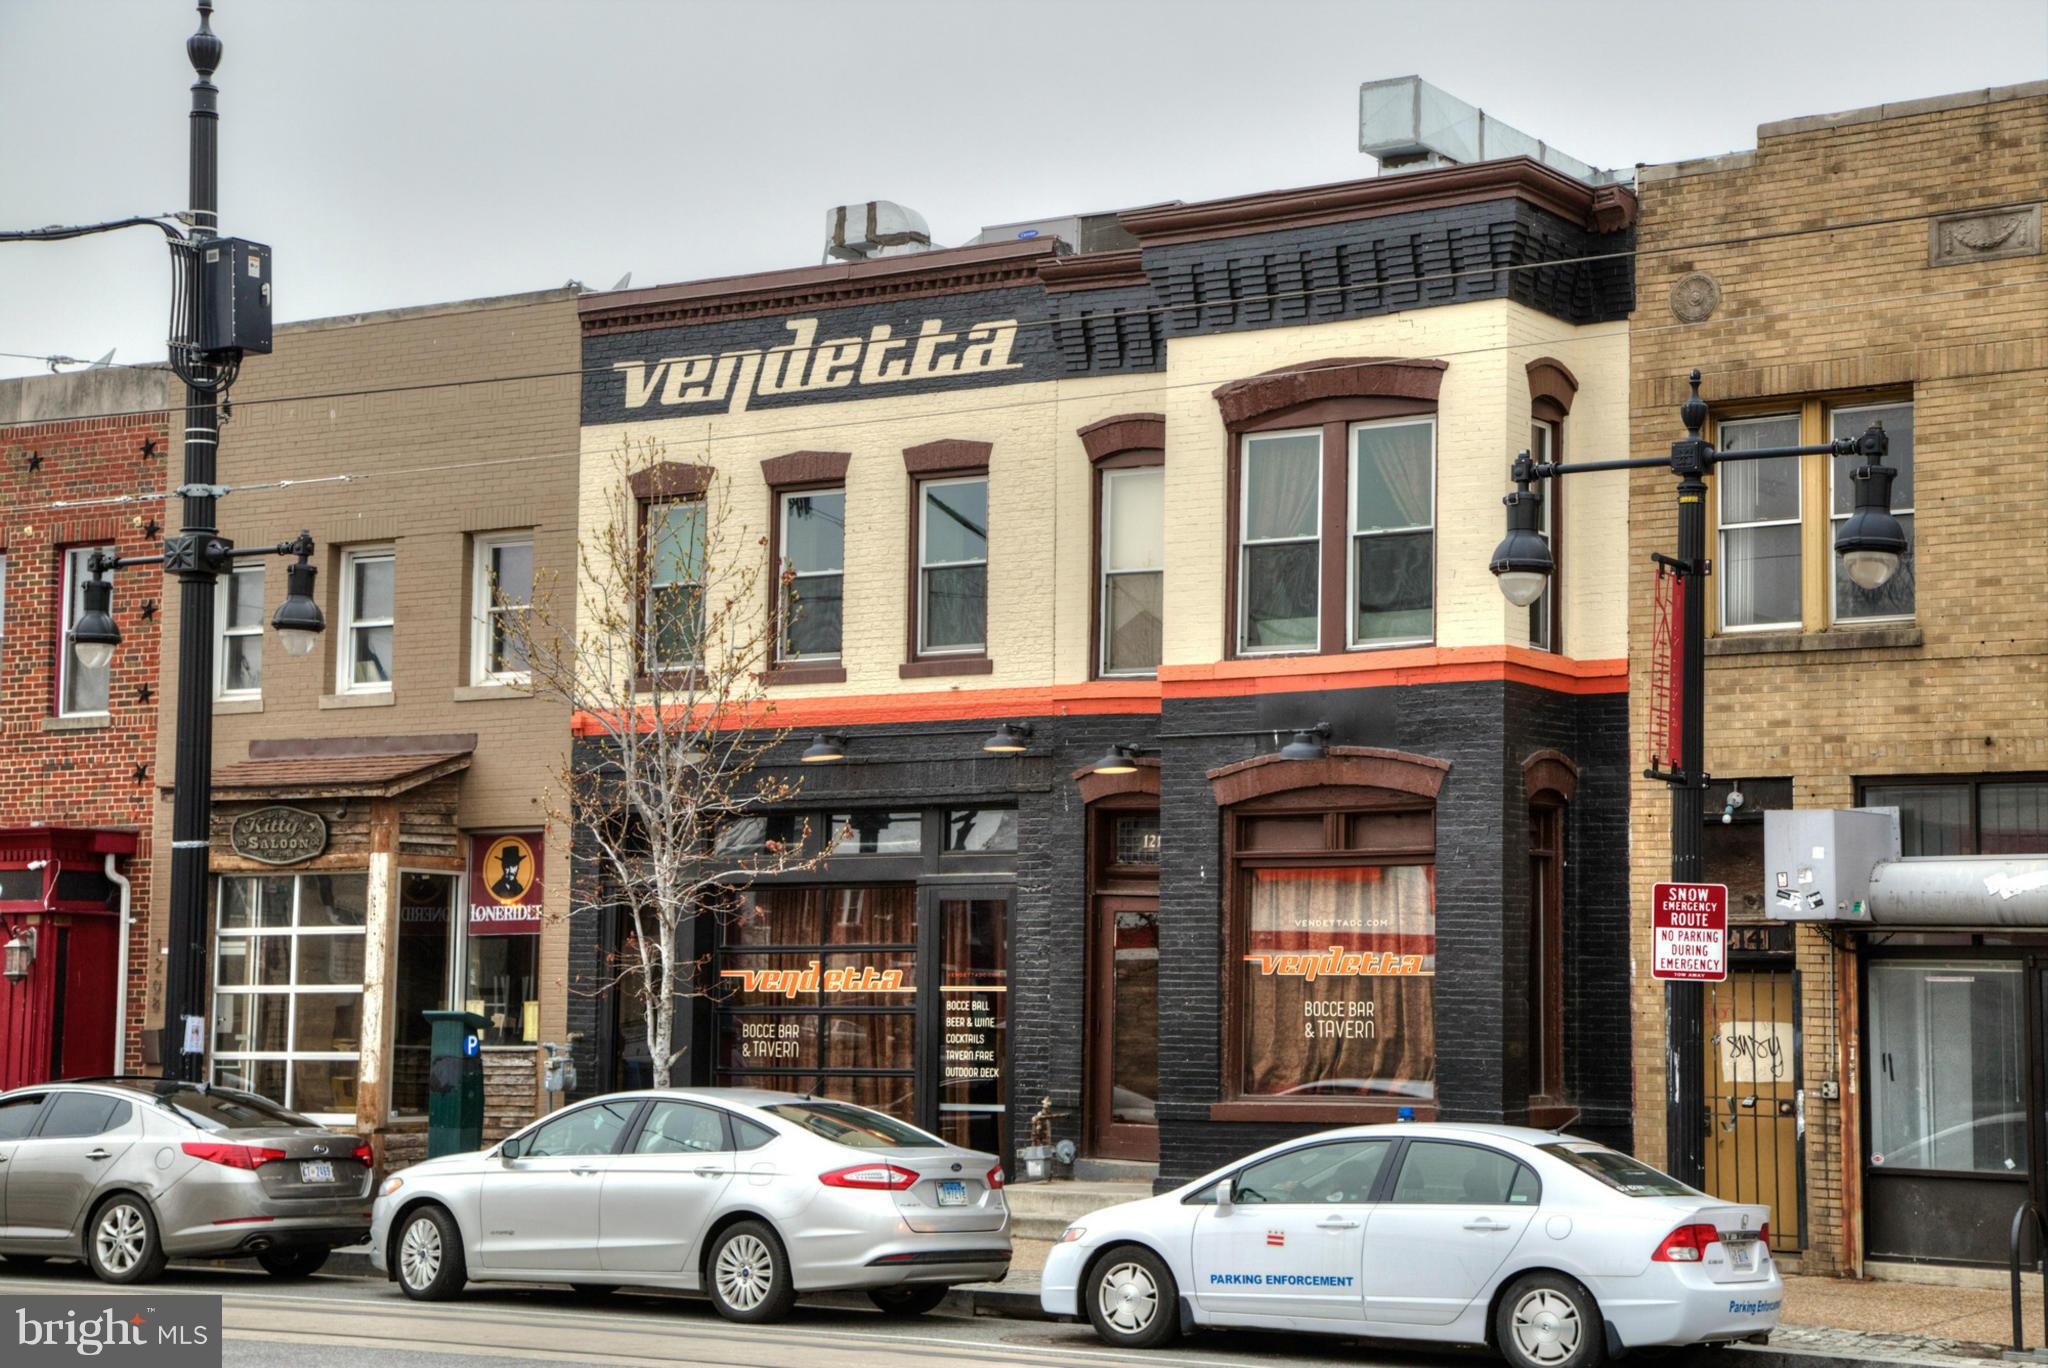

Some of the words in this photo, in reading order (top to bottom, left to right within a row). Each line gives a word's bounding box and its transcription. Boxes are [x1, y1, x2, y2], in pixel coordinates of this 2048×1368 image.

[612, 318, 1024, 414] vendetta
[242, 817, 316, 837] Kitty's
[248, 837, 309, 849] SALOON
[1669, 888, 1709, 901] SNOW
[1663, 901, 1717, 912] EMERGENCY
[1294, 919, 1388, 928] VENDETTADC.COM
[1671, 913, 1708, 927] ROUTE
[1662, 930, 1674, 941] NO
[1678, 930, 1719, 943] PARKING
[1672, 944, 1708, 956] DURING
[1243, 946, 1435, 981] vendetta
[1660, 958, 1719, 970] EMERGENCY
[720, 960, 917, 999] vendetta
[946, 1001, 970, 1011] BOCCE
[972, 1001, 989, 1011] BALL
[1304, 1001, 1345, 1017] BOCCE
[1349, 1001, 1374, 1017] BAR
[946, 1017, 965, 1027] BEER
[966, 1017, 973, 1027] &
[974, 1017, 995, 1028] WINE
[742, 1024, 776, 1038] BOCCE
[778, 1024, 799, 1038] BAR
[1304, 1021, 1315, 1038] &
[1317, 1020, 1374, 1039] TAVERN
[468, 1035, 478, 1055] P
[946, 1034, 985, 1044] COCKTAILS
[742, 1042, 751, 1057] &
[752, 1041, 799, 1058] TAVERN
[946, 1050, 974, 1060] TAVERN
[975, 1051, 994, 1061] FARE
[945, 1067, 979, 1077] OUTDOOR
[980, 1068, 999, 1078] DECK
[1210, 1274, 1262, 1285] PARKING
[1266, 1275, 1354, 1286] ENFORCEMENT
[1729, 1300, 1756, 1316] Parking
